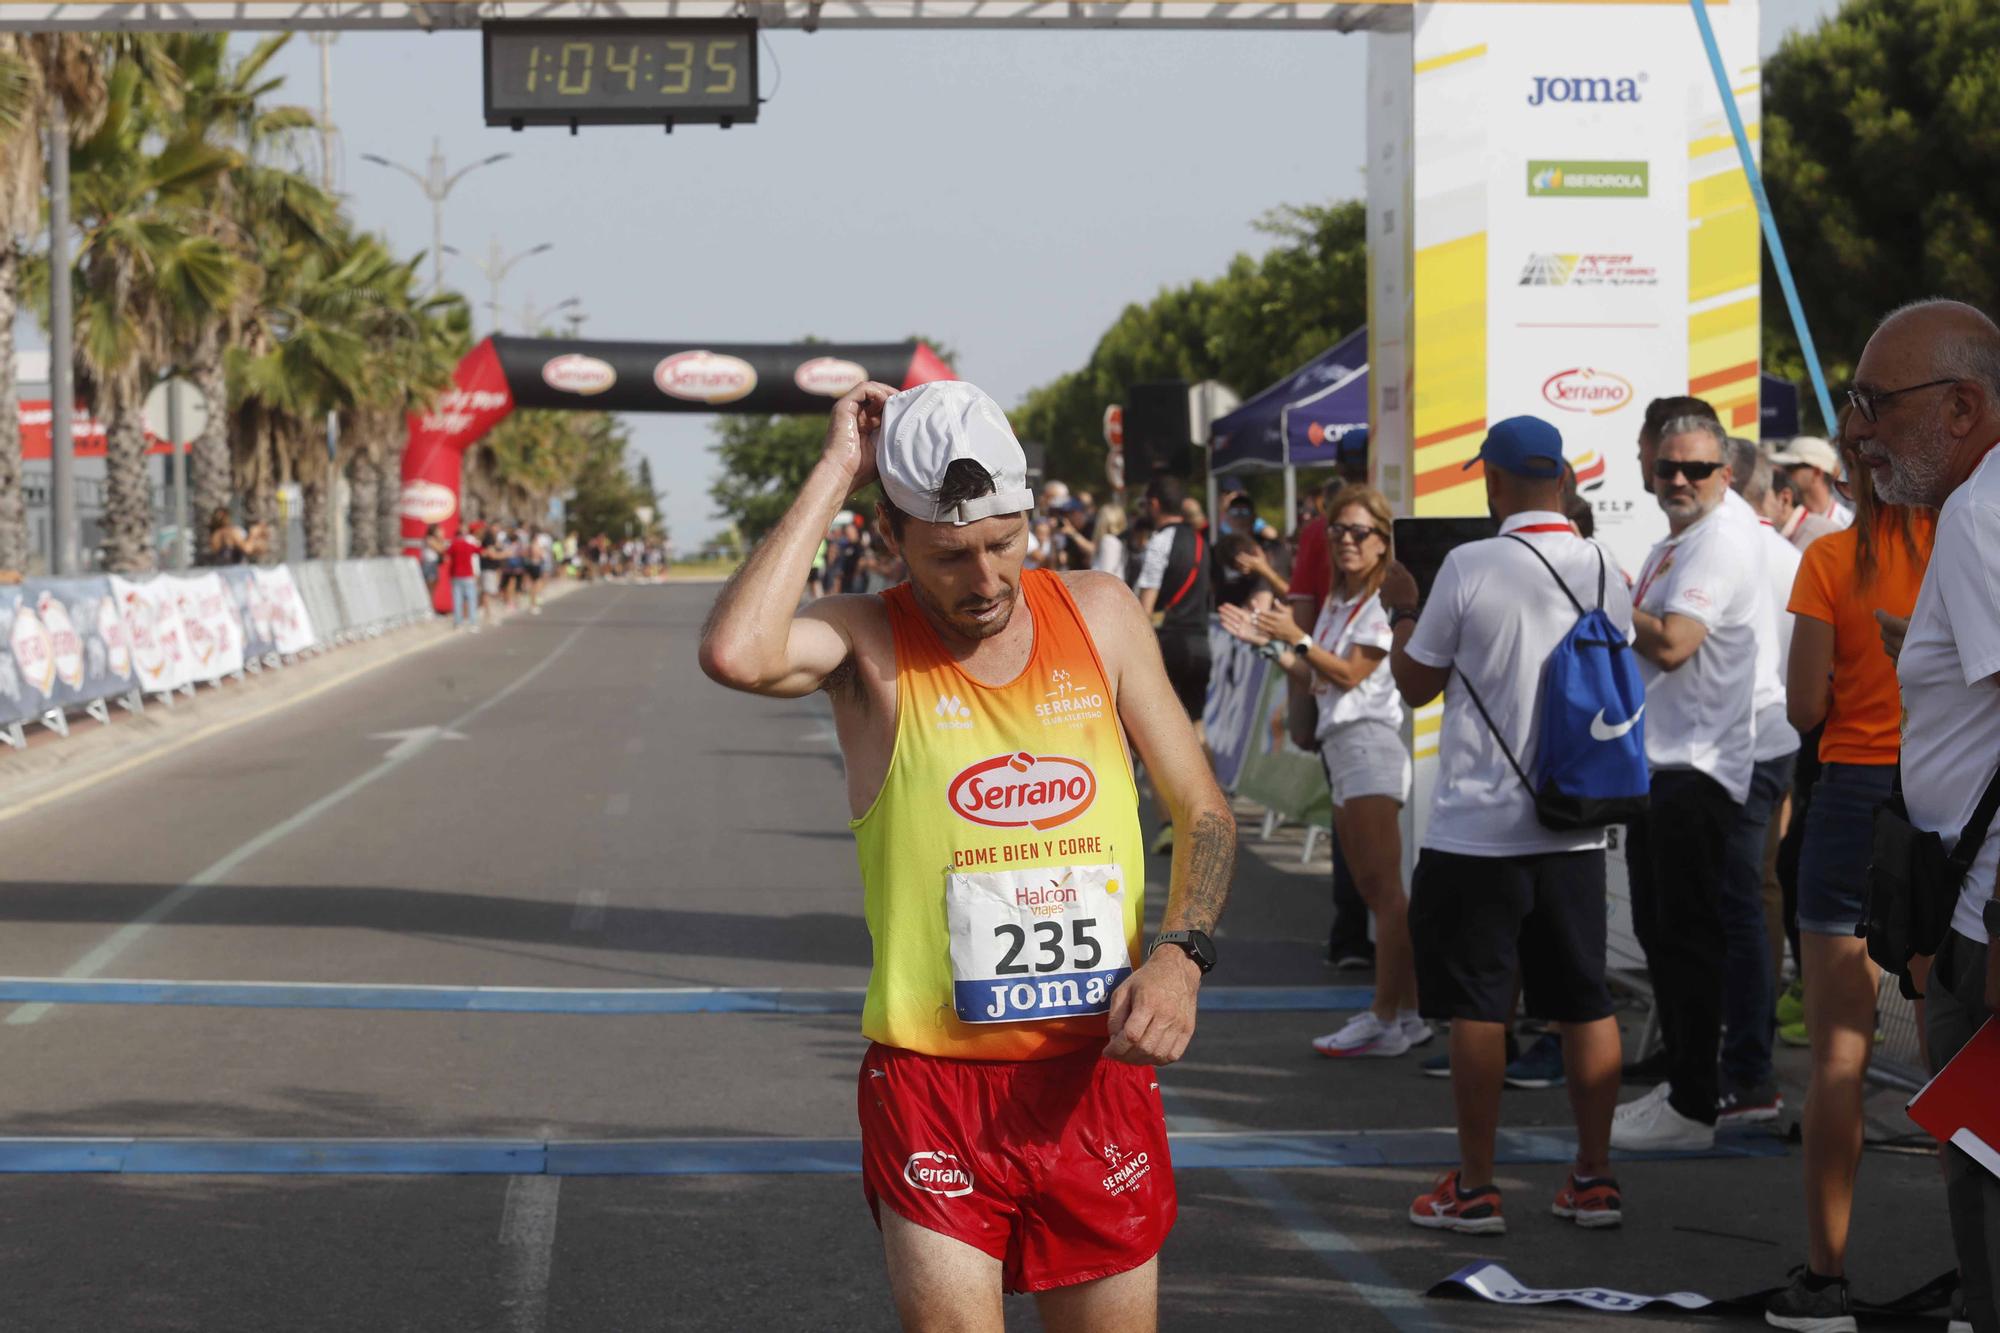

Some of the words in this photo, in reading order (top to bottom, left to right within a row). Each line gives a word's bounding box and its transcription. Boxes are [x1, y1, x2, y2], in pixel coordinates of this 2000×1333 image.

[527, 41, 737, 94] 1:04:35
[1563, 173, 1643, 188] IBERDROLA
[1554, 381, 1624, 400] Serrano
[1035, 694, 1102, 717] SERRANO
[964, 776, 1086, 811] Serrano
[954, 847, 997, 867] COME
[1003, 842, 1039, 862] BIEN
[1044, 841, 1053, 857] Y
[1059, 836, 1101, 856] CORRE
[994, 918, 1101, 975] 235
